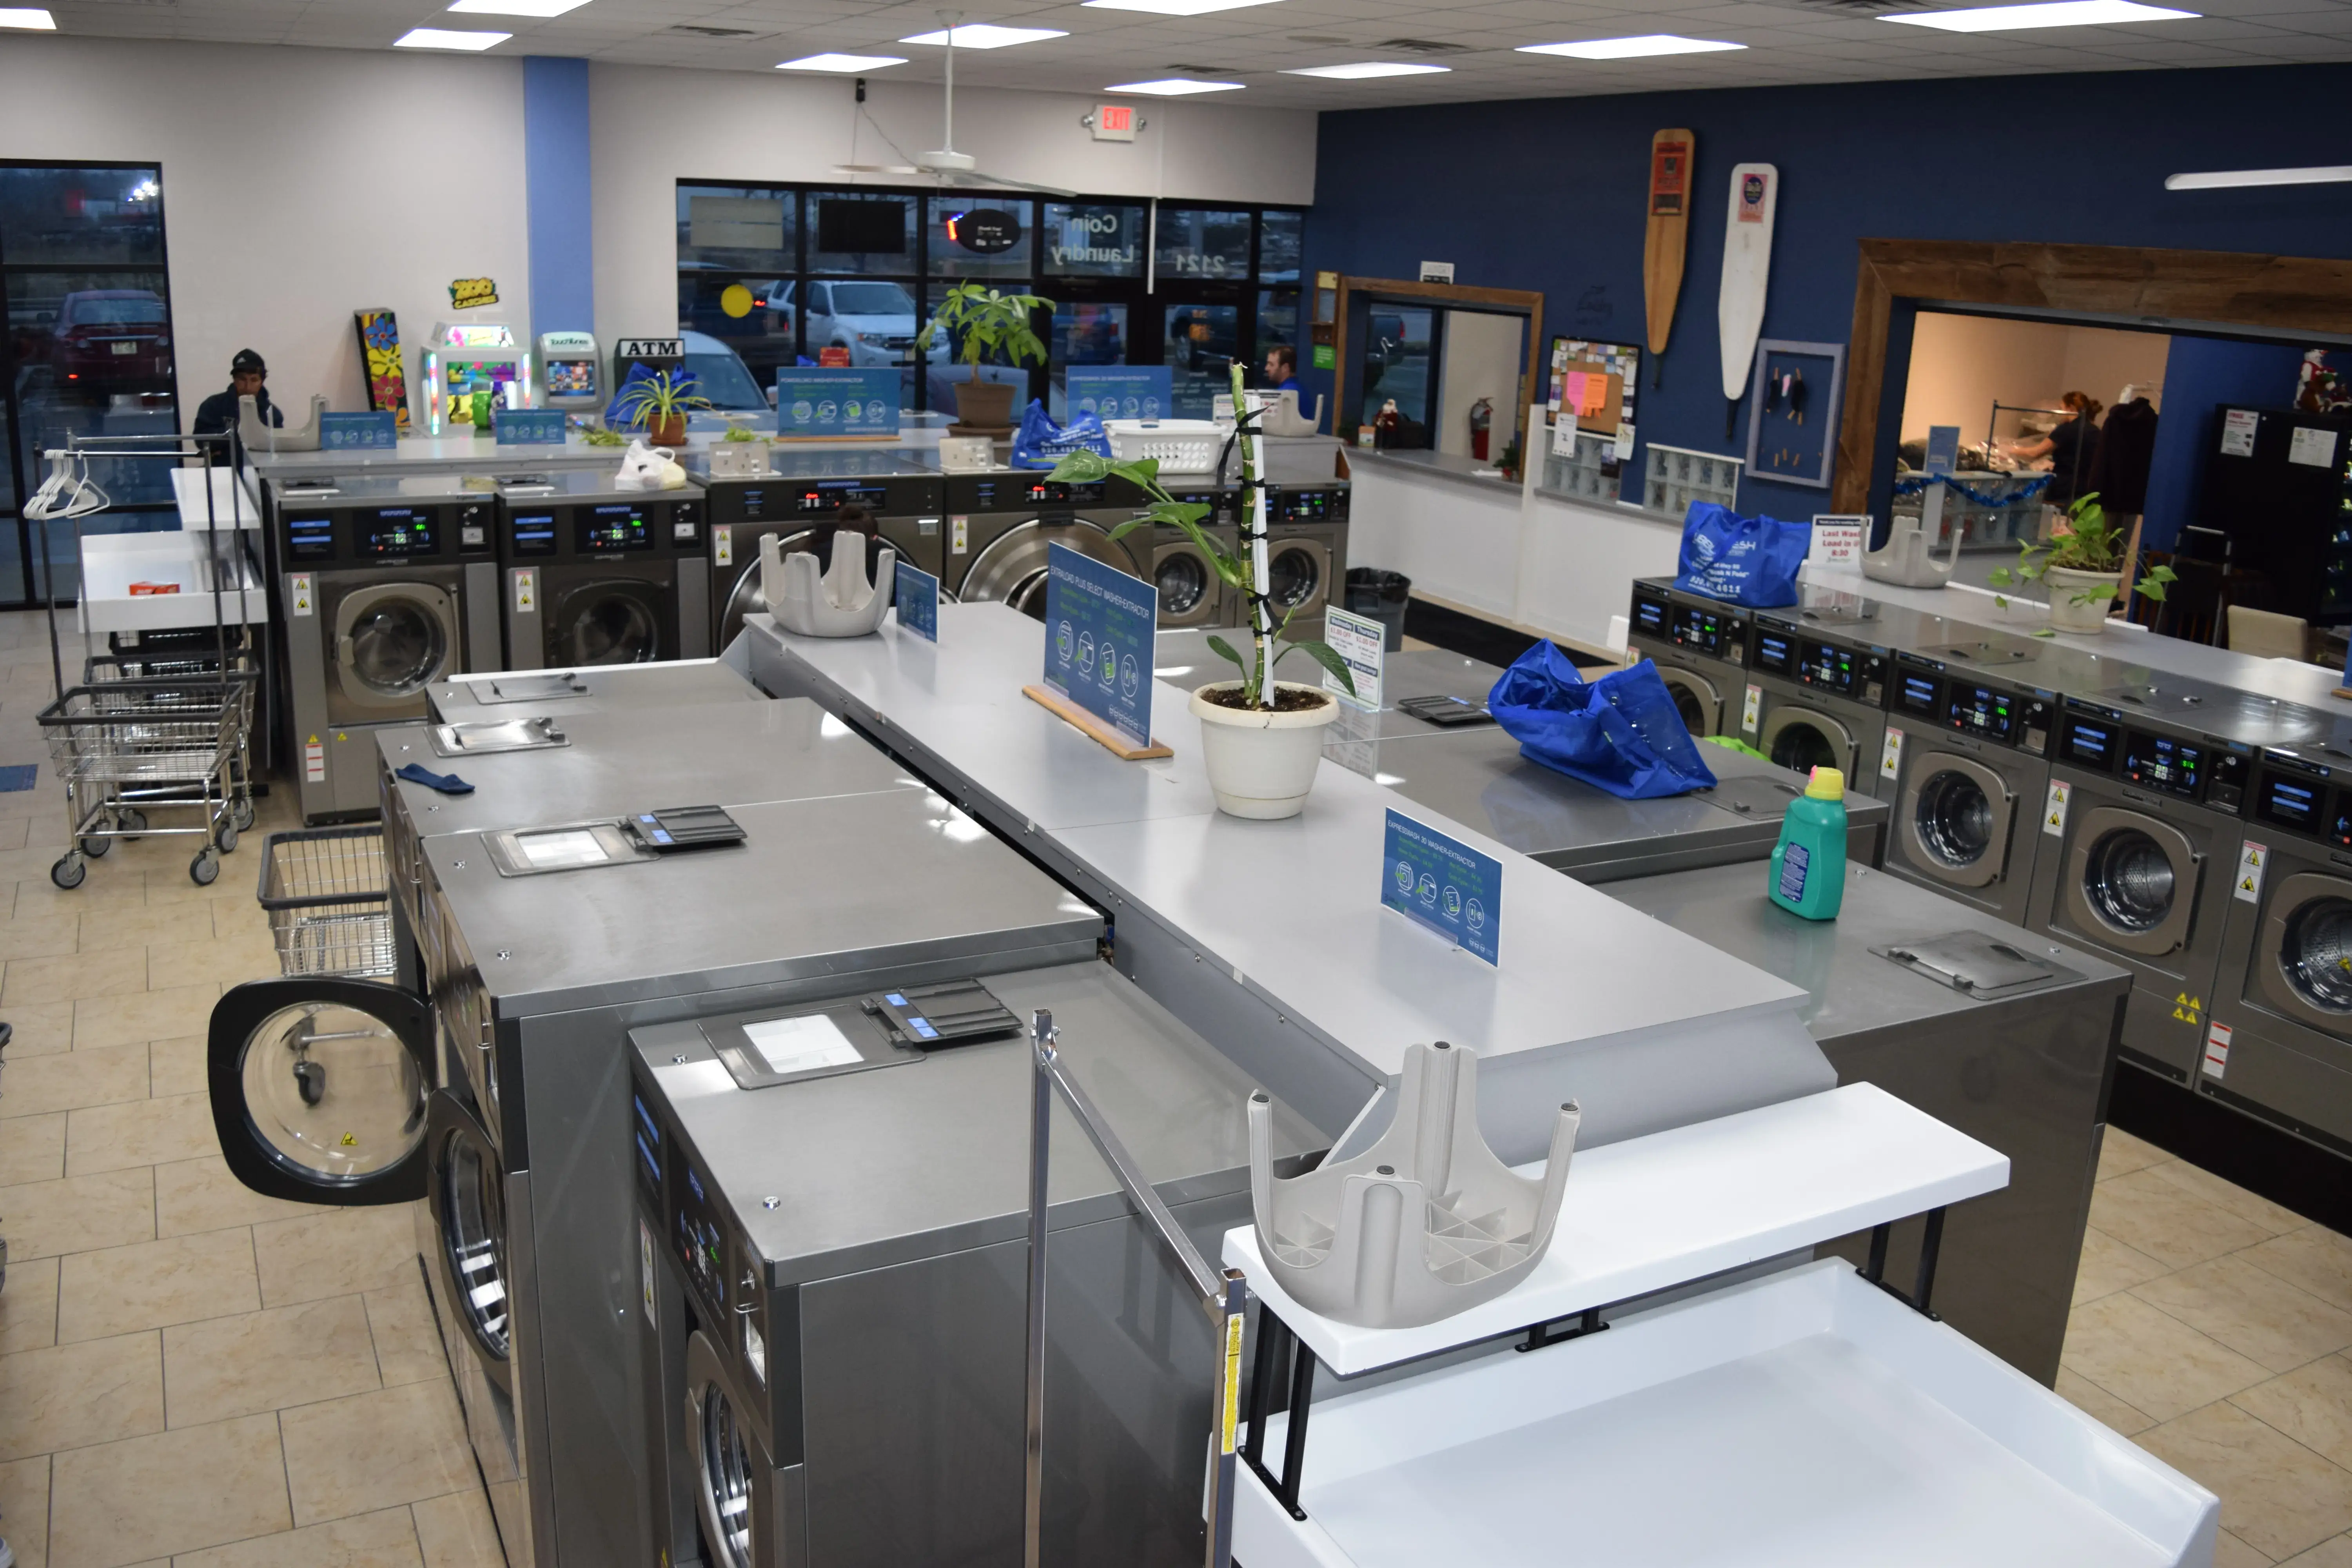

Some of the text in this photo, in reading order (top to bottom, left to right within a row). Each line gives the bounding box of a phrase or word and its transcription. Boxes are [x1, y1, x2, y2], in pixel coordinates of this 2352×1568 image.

[1103, 107, 1132, 131] EXIT
[628, 342, 677, 355] ATM
[1051, 565, 1074, 584] EXTRALOAD
[1075, 576, 1086, 590] PLUS
[1086, 582, 1103, 597] SELECT
[1103, 589, 1149, 620] WASHER-EXTRACTOR
[1357, 625, 1379, 640] Thursday
[1388, 819, 1420, 841] EXPRESSWASH
[1421, 836, 1427, 844] 30
[1427, 839, 1476, 869] WASHER-EXTRACTOR
